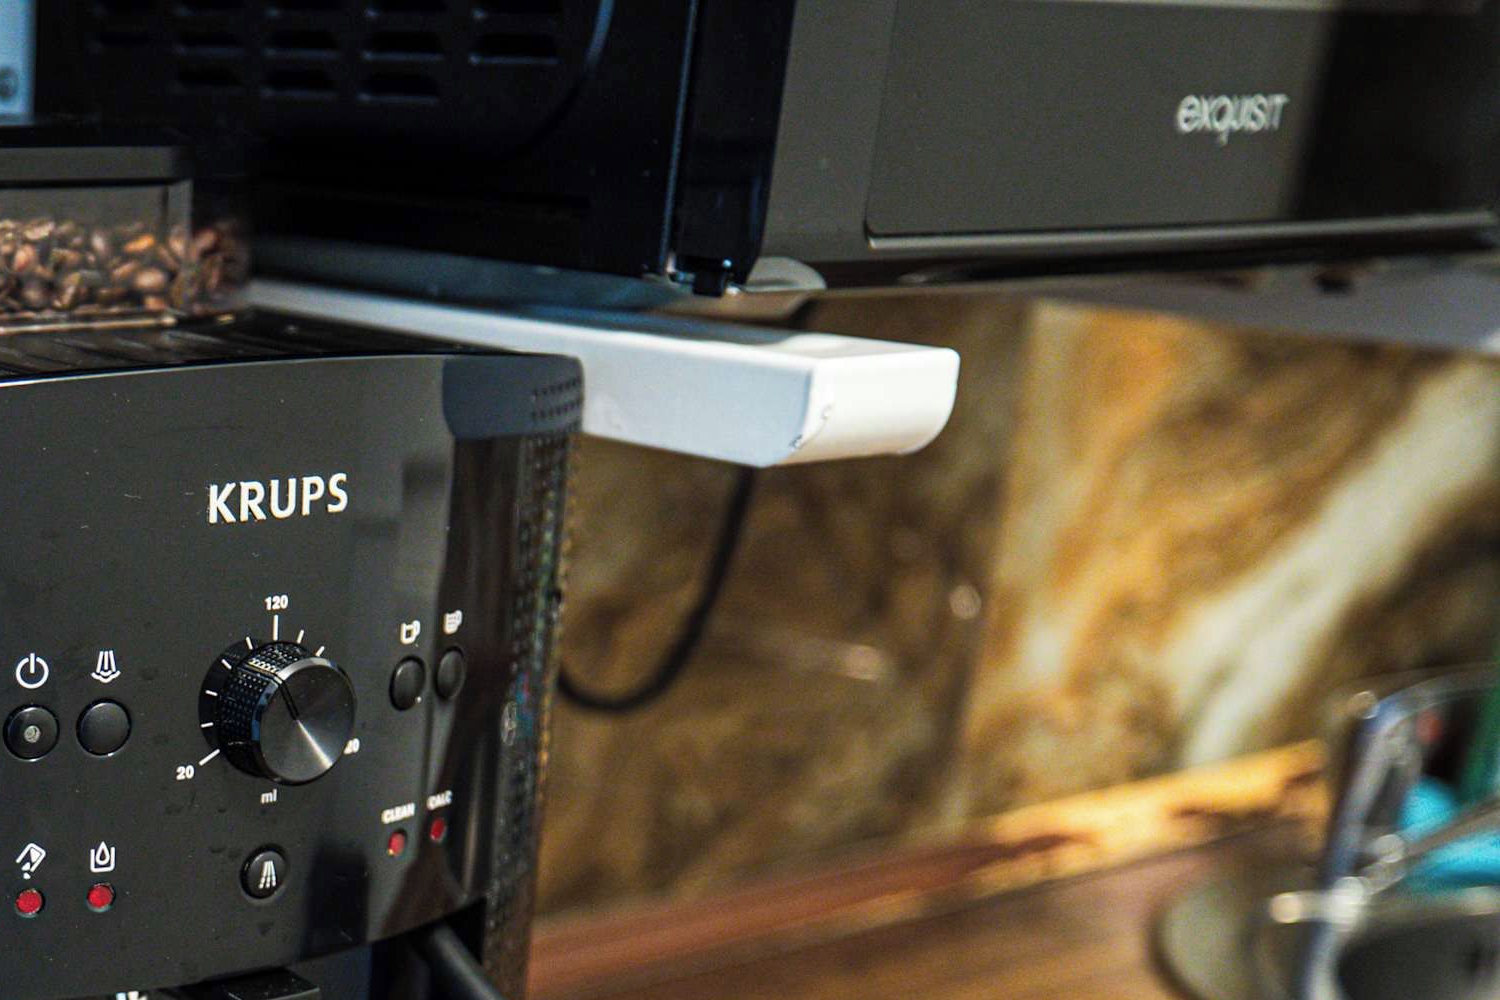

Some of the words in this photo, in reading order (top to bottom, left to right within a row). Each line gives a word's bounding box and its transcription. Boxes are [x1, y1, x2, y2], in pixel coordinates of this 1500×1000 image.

[208, 472, 349, 524] KRUPS
[264, 595, 289, 611] 120
[175, 765, 195, 781] 20
[260, 789, 278, 804] ml
